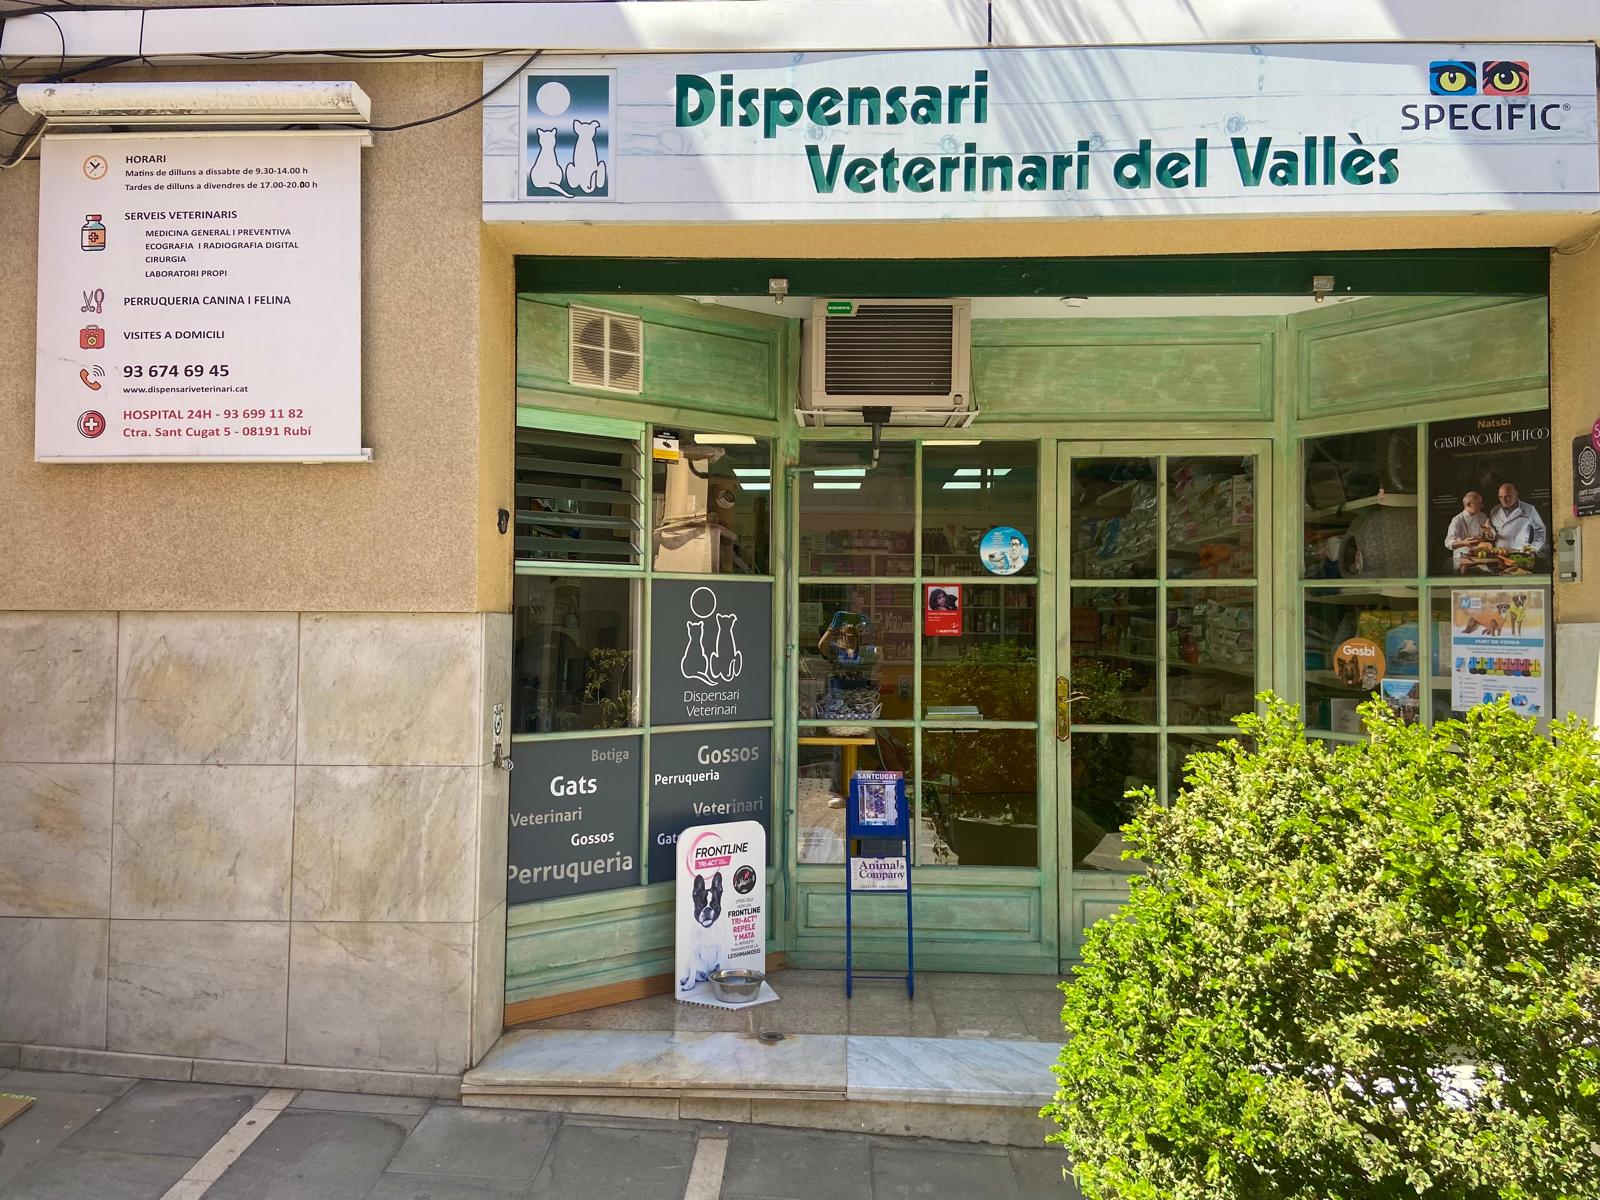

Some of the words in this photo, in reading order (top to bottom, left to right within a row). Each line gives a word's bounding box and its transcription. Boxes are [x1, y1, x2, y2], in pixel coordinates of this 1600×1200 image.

[675, 70, 989, 139] Dispensari
[125, 154, 167, 164] HORARI
[804, 140, 1090, 193] Veterinari
[1113, 137, 1208, 188] del
[1230, 132, 1400, 188] Vallès
[125, 168, 153, 178] Matins
[156, 168, 167, 177] de
[168, 167, 197, 177] dilluns
[205, 167, 241, 176] dissabte
[243, 167, 254, 175] de
[255, 167, 301, 175] 9.30-14.00
[302, 167, 308, 175] h
[125, 183, 152, 192] Tardes
[154, 183, 165, 191] de
[167, 182, 195, 191] dilluns
[204, 182, 245, 190] divendres
[247, 181, 258, 189] de
[260, 181, 310, 189] 17.00-20.00
[124, 211, 166, 221] SERVEIS
[169, 210, 238, 220] VETERINARIS
[145, 229, 189, 237] MEDICINA
[191, 228, 230, 237] GENERAL
[237, 228, 291, 236] PREVENTIVA
[145, 242, 194, 250] ECOGRAFIA
[203, 242, 263, 250] RADIOGRAFIA
[265, 241, 299, 249] DIGITAL
[145, 256, 187, 264] CIRURGIA
[145, 270, 199, 278] LABORATORI
[201, 269, 227, 278] PROPI
[123, 296, 200, 307] PERRUQUERIA
[202, 296, 245, 305] CANINA
[254, 295, 291, 305] FELINA
[123, 331, 162, 341] VISITES
[164, 331, 173, 340] A
[175, 330, 225, 340] DOMICILI
[123, 365, 143, 378] 93
[148, 365, 179, 378] 674
[183, 365, 204, 377] 69
[209, 364, 229, 377] 45
[122, 385, 249, 394] www.dispensariveterinari.cat
[123, 410, 183, 420] HOSPITAL
[187, 409, 212, 420] 24H
[223, 409, 239, 419] 93
[242, 409, 266, 419] 699
[269, 409, 285, 419] 11
[288, 408, 304, 418] 82
[1477, 416, 1512, 429] Natsbi
[122, 427, 152, 438] Ctra.
[155, 427, 182, 437] Sant
[185, 427, 220, 439] Cugat
[223, 427, 231, 437] 5
[242, 426, 280, 437] 08191
[283, 425, 312, 436] Rubí
[1434, 431, 1510, 449] GASTRONOMIC
[1342, 645, 1376, 657] Gosbi
[683, 689, 740, 704] Dispensari
[686, 704, 737, 716] Veterinari
[591, 749, 629, 763] Botiga
[697, 745, 759, 765] Gossos
[654, 769, 720, 786] Perruqueria
[550, 775, 598, 796] Gats
[693, 797, 763, 817] Veterinari
[510, 807, 582, 827] Veterinari
[570, 831, 615, 847] Gossos
[657, 832, 683, 846] Gat
[695, 842, 748, 858] FRONTLINE
[859, 870, 905, 880] Company
[728, 906, 761, 918] FRONTLINE
[732, 923, 756, 933] REPELE
[739, 932, 755, 940] MATA
[728, 948, 761, 959] LEISHMANIOSIS
